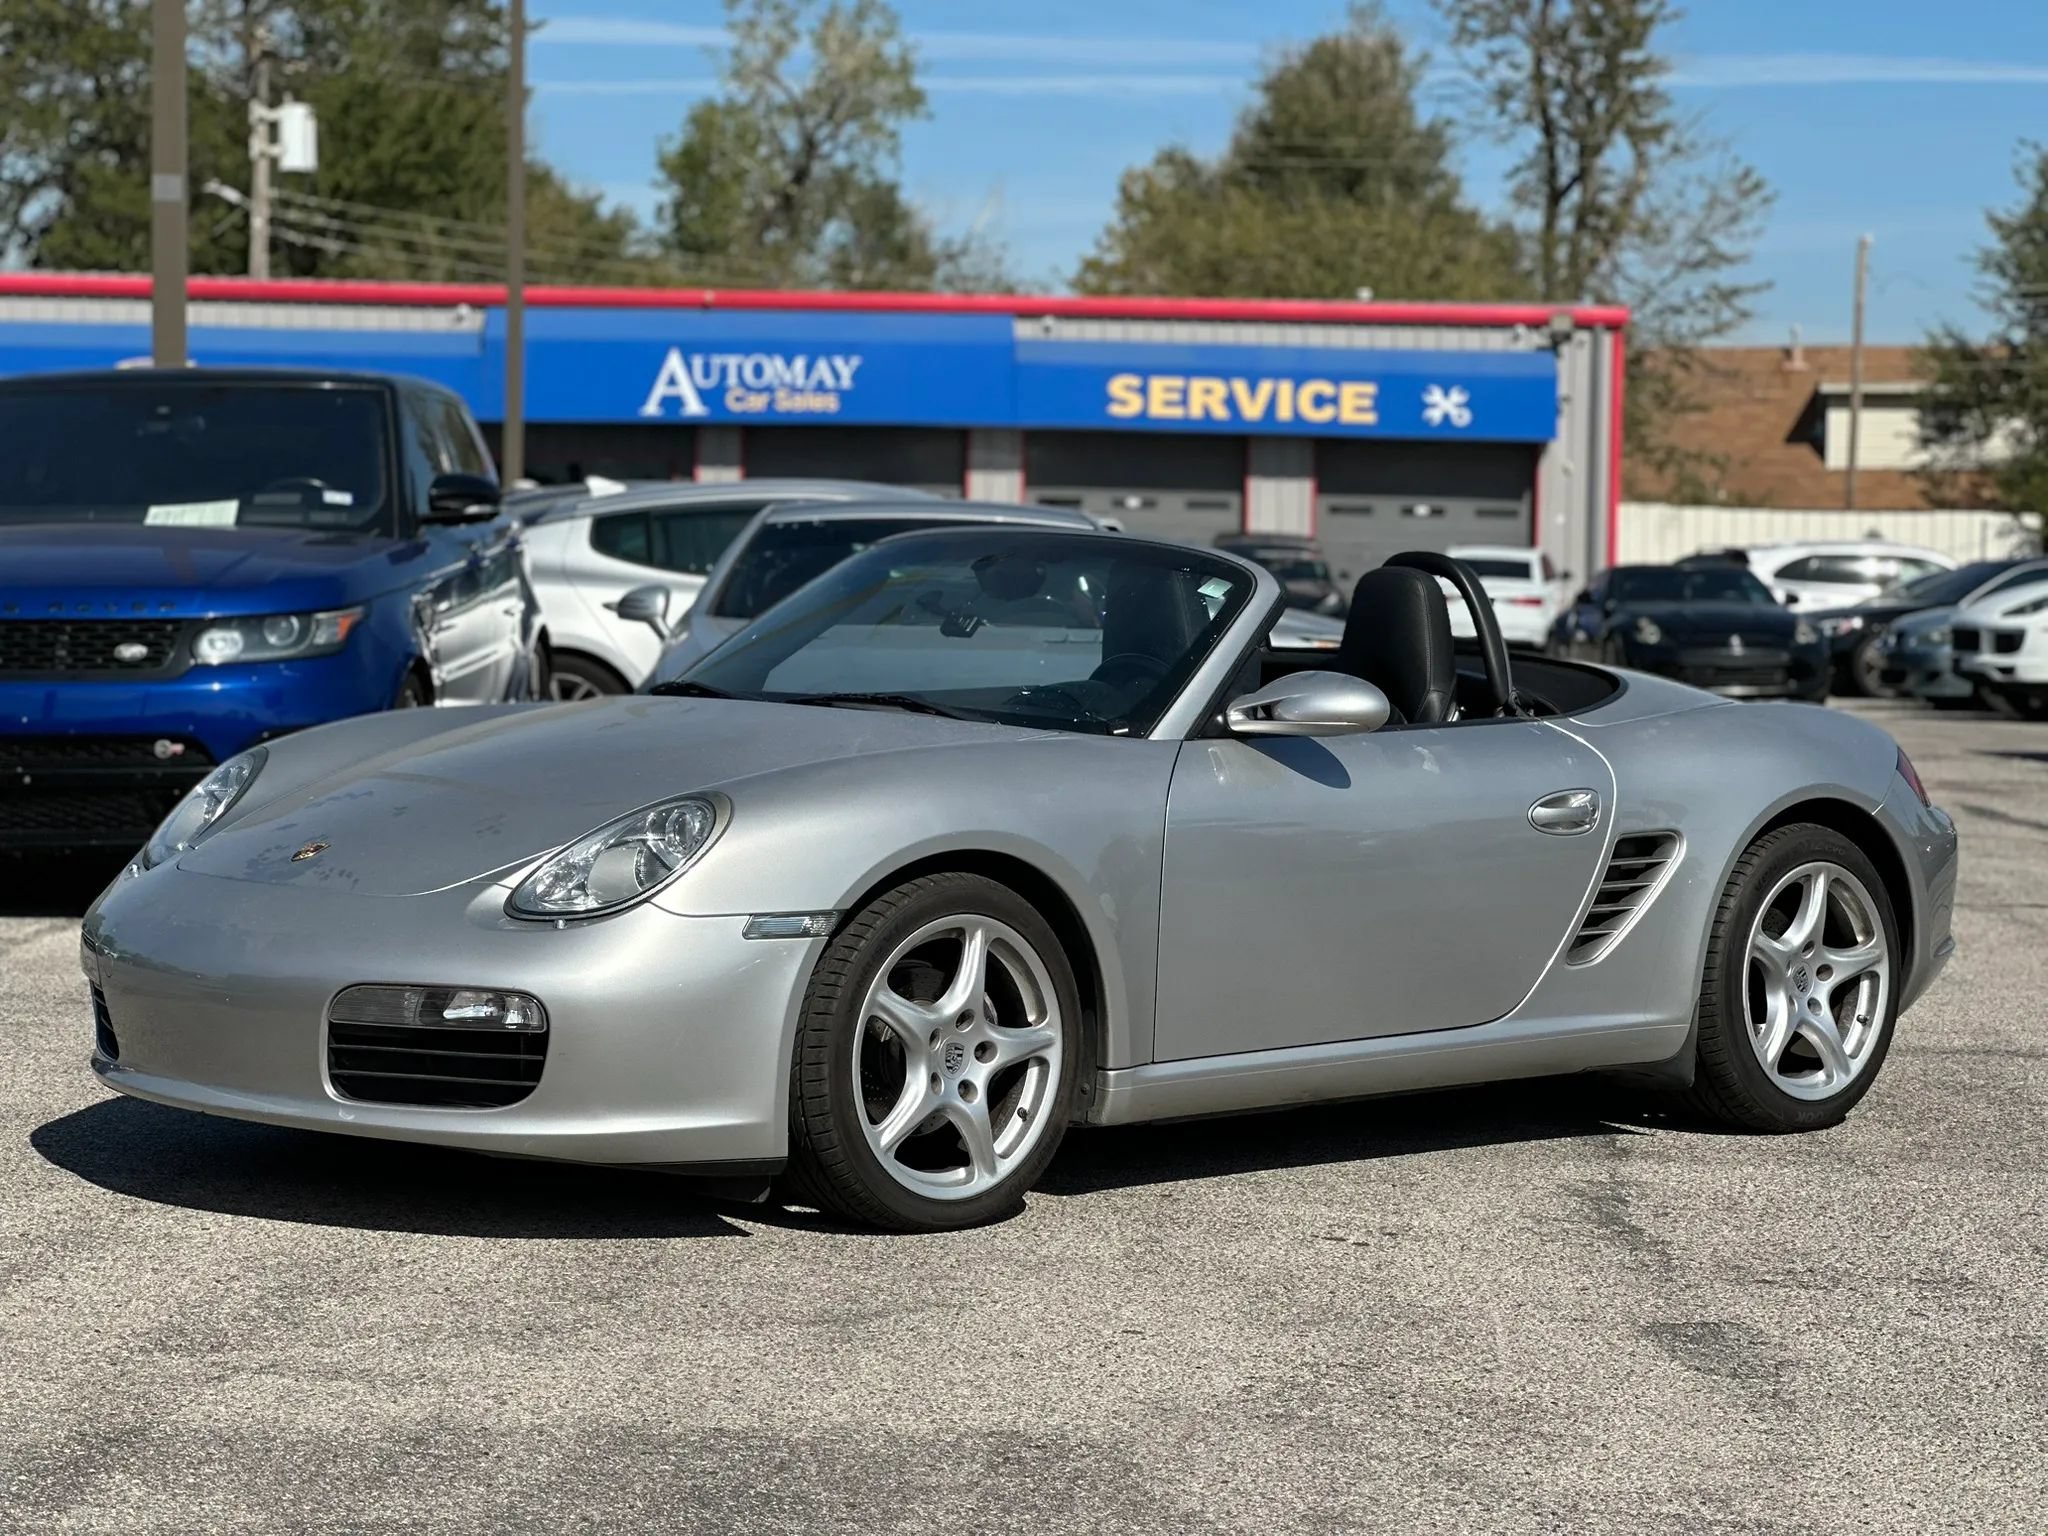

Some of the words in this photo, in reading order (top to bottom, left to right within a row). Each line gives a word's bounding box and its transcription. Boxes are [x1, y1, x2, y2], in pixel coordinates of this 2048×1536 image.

[639, 347, 861, 416] AUTOMAY
[725, 388, 768, 413] Car
[773, 389, 840, 414] Sales
[1106, 374, 1378, 426] SERVICE
